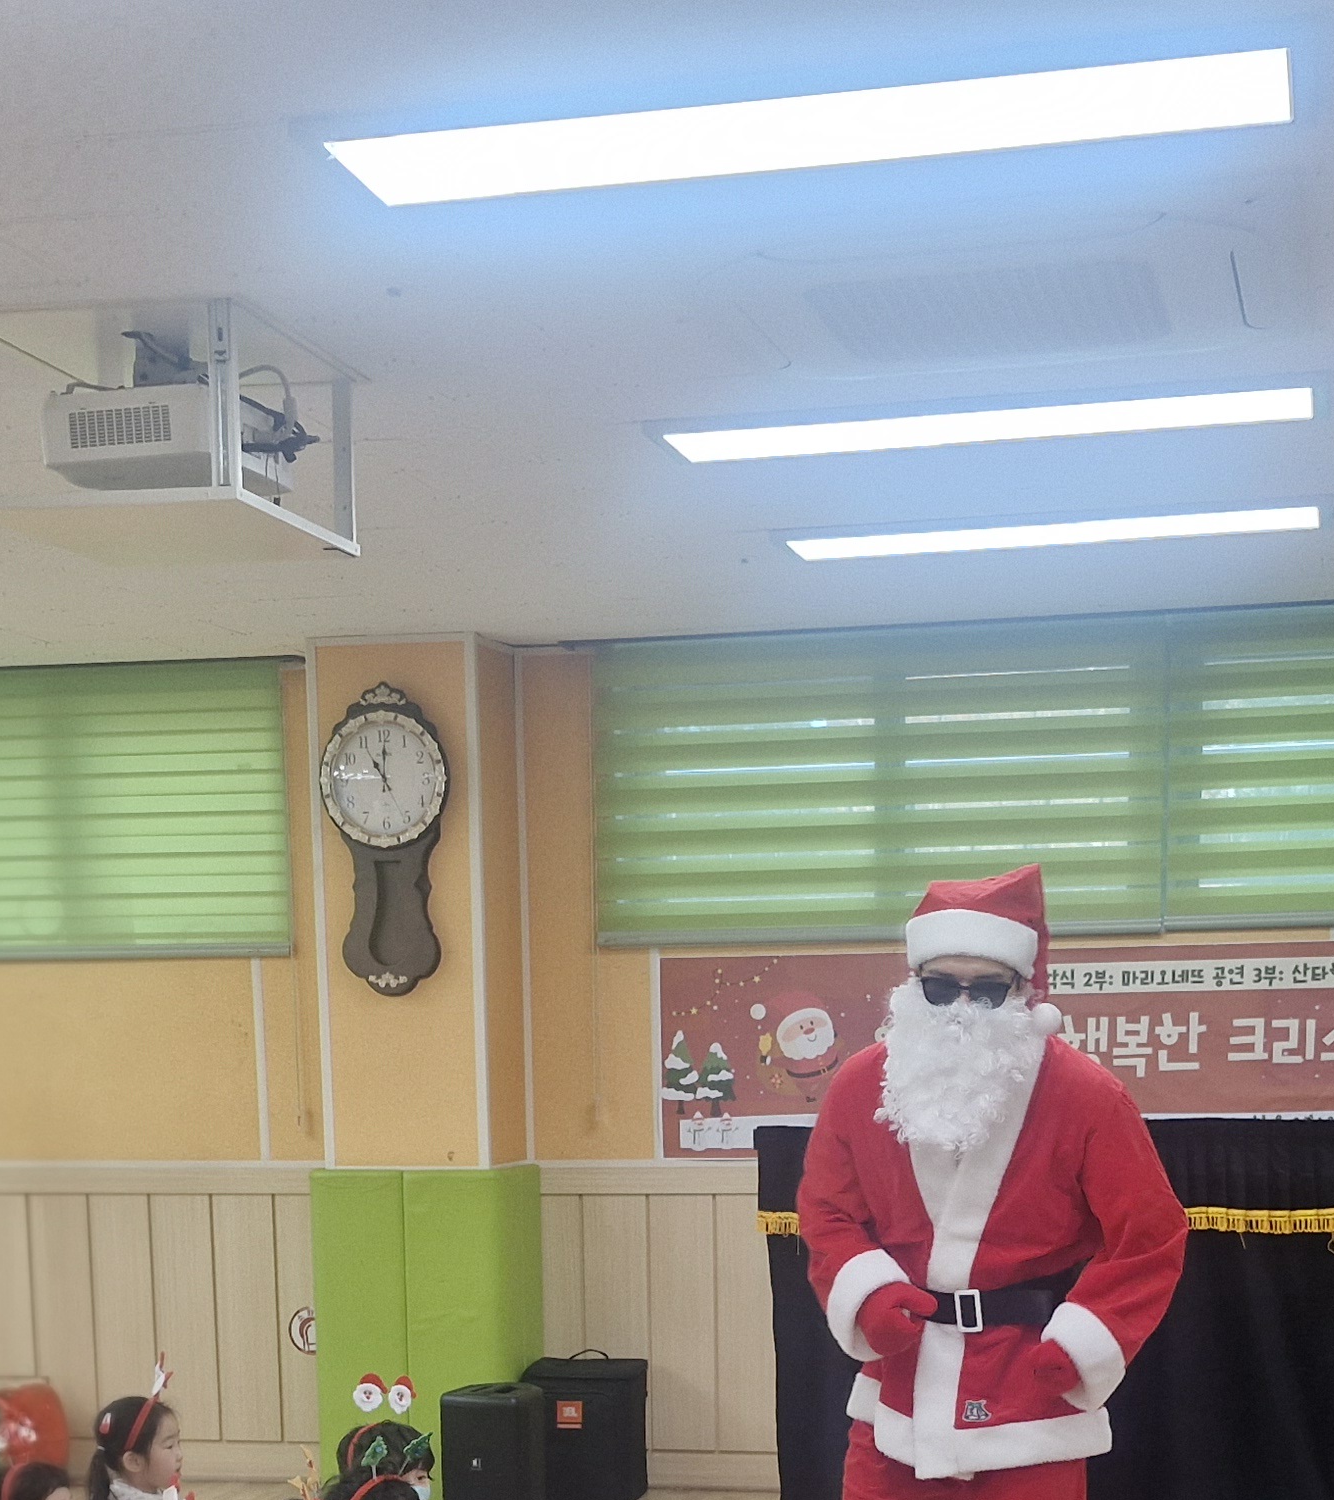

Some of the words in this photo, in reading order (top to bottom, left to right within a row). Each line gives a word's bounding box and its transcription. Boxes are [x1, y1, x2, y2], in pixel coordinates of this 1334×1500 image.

[358, 735, 368, 749] 11
[377, 729, 391, 743] 12
[402, 734, 407, 748] 1
[344, 752, 356, 766] 10
[417, 750, 424, 765] 2
[422, 771, 430, 786] 3
[347, 795, 355, 809] 8
[362, 811, 370, 825] 7
[382, 817, 391, 830] 6
[402, 810, 411, 824] 5
[1082, 969, 1114, 991] 2부:
[1121, 968, 1205, 987] 마리오네뜨
[1211, 964, 1245, 988] 공연
[1252, 965, 1284, 987] 3부:
[1056, 1011, 1207, 1078] 행복한
